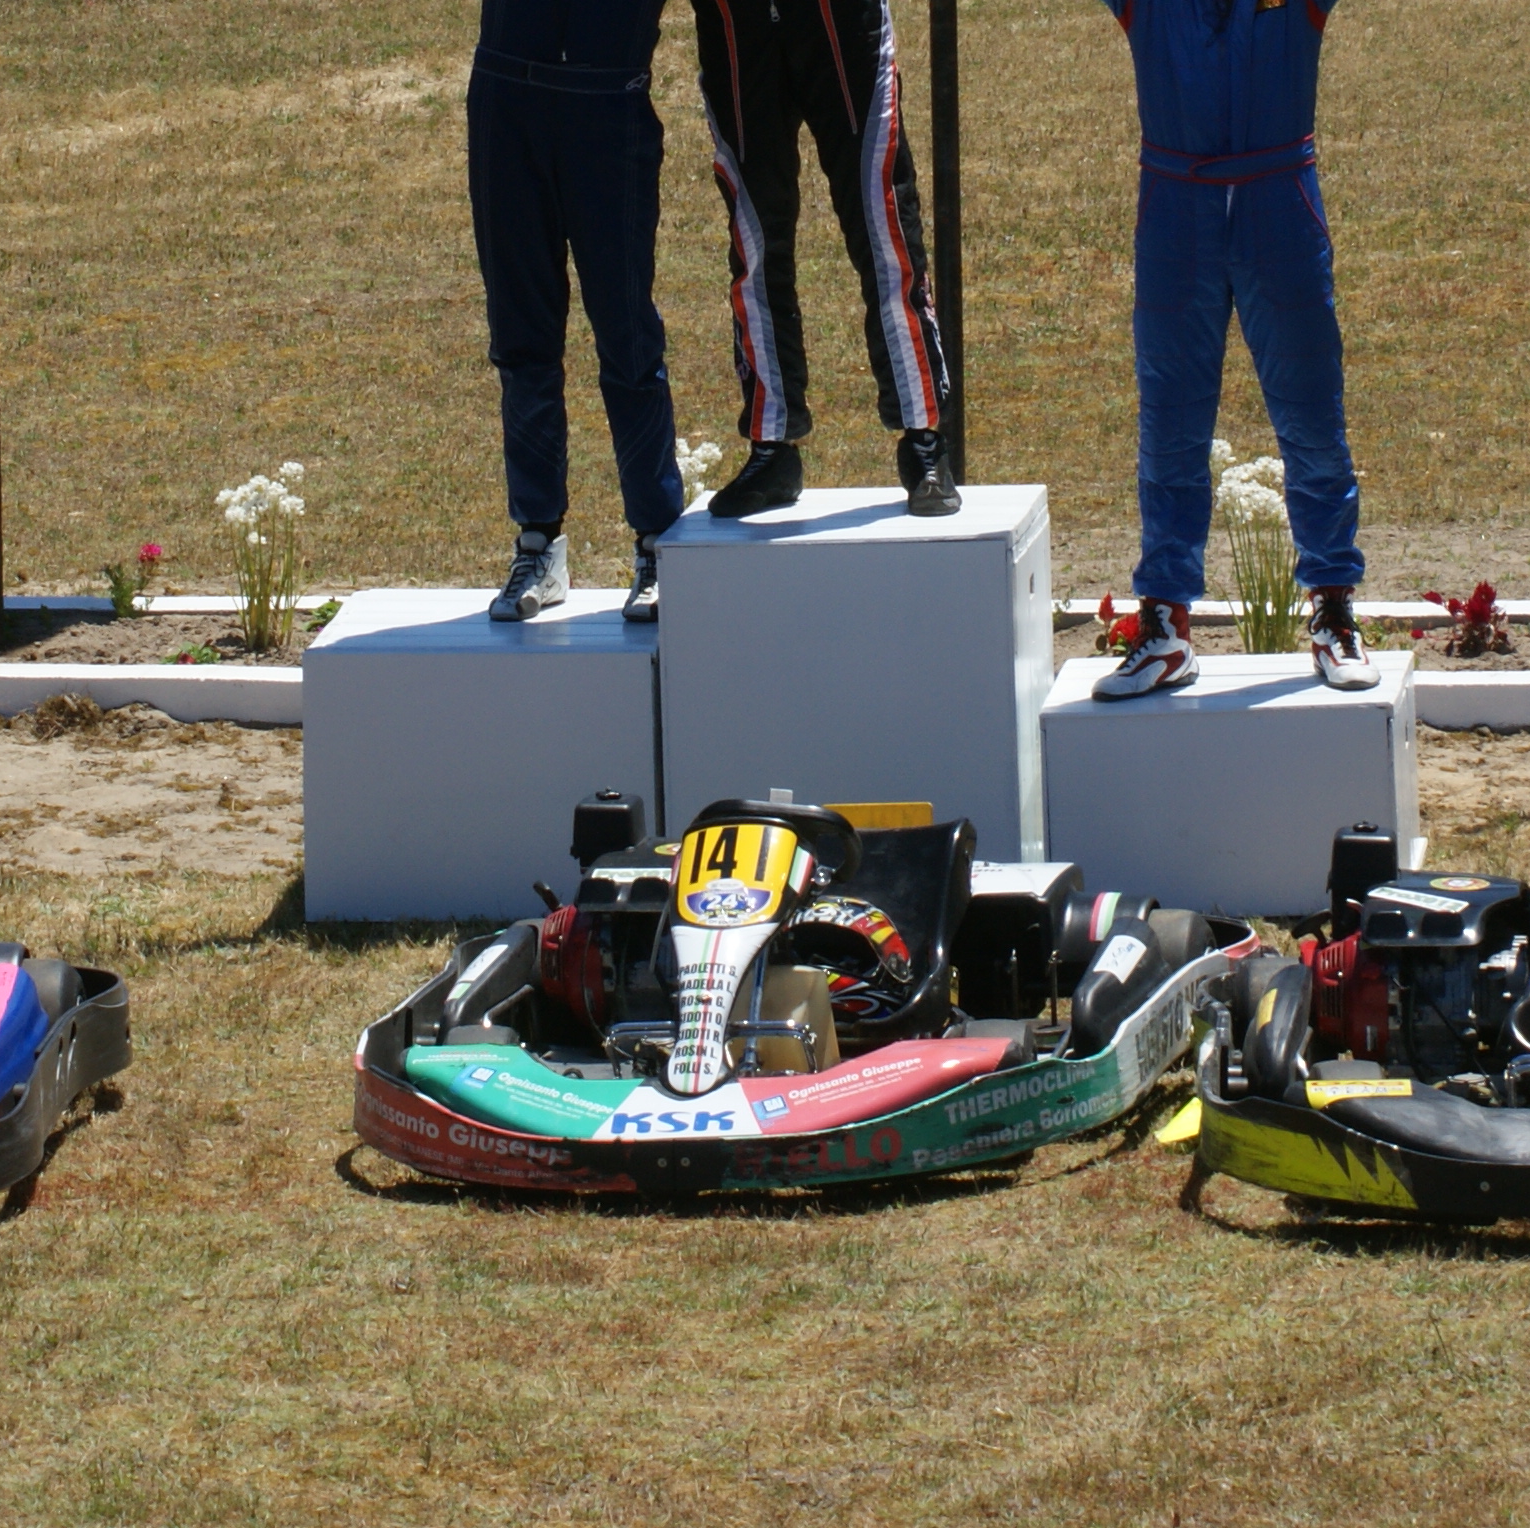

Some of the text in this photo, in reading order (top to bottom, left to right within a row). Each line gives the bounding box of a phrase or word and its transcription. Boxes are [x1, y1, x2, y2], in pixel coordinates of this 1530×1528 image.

[689, 825, 773, 884] 141
[788, 1072, 860, 1100] Ognissanto
[862, 1057, 922, 1078] Giuseppe
[944, 1062, 1096, 1125] THERMOCLIMA
[610, 1110, 736, 1135] KSK
